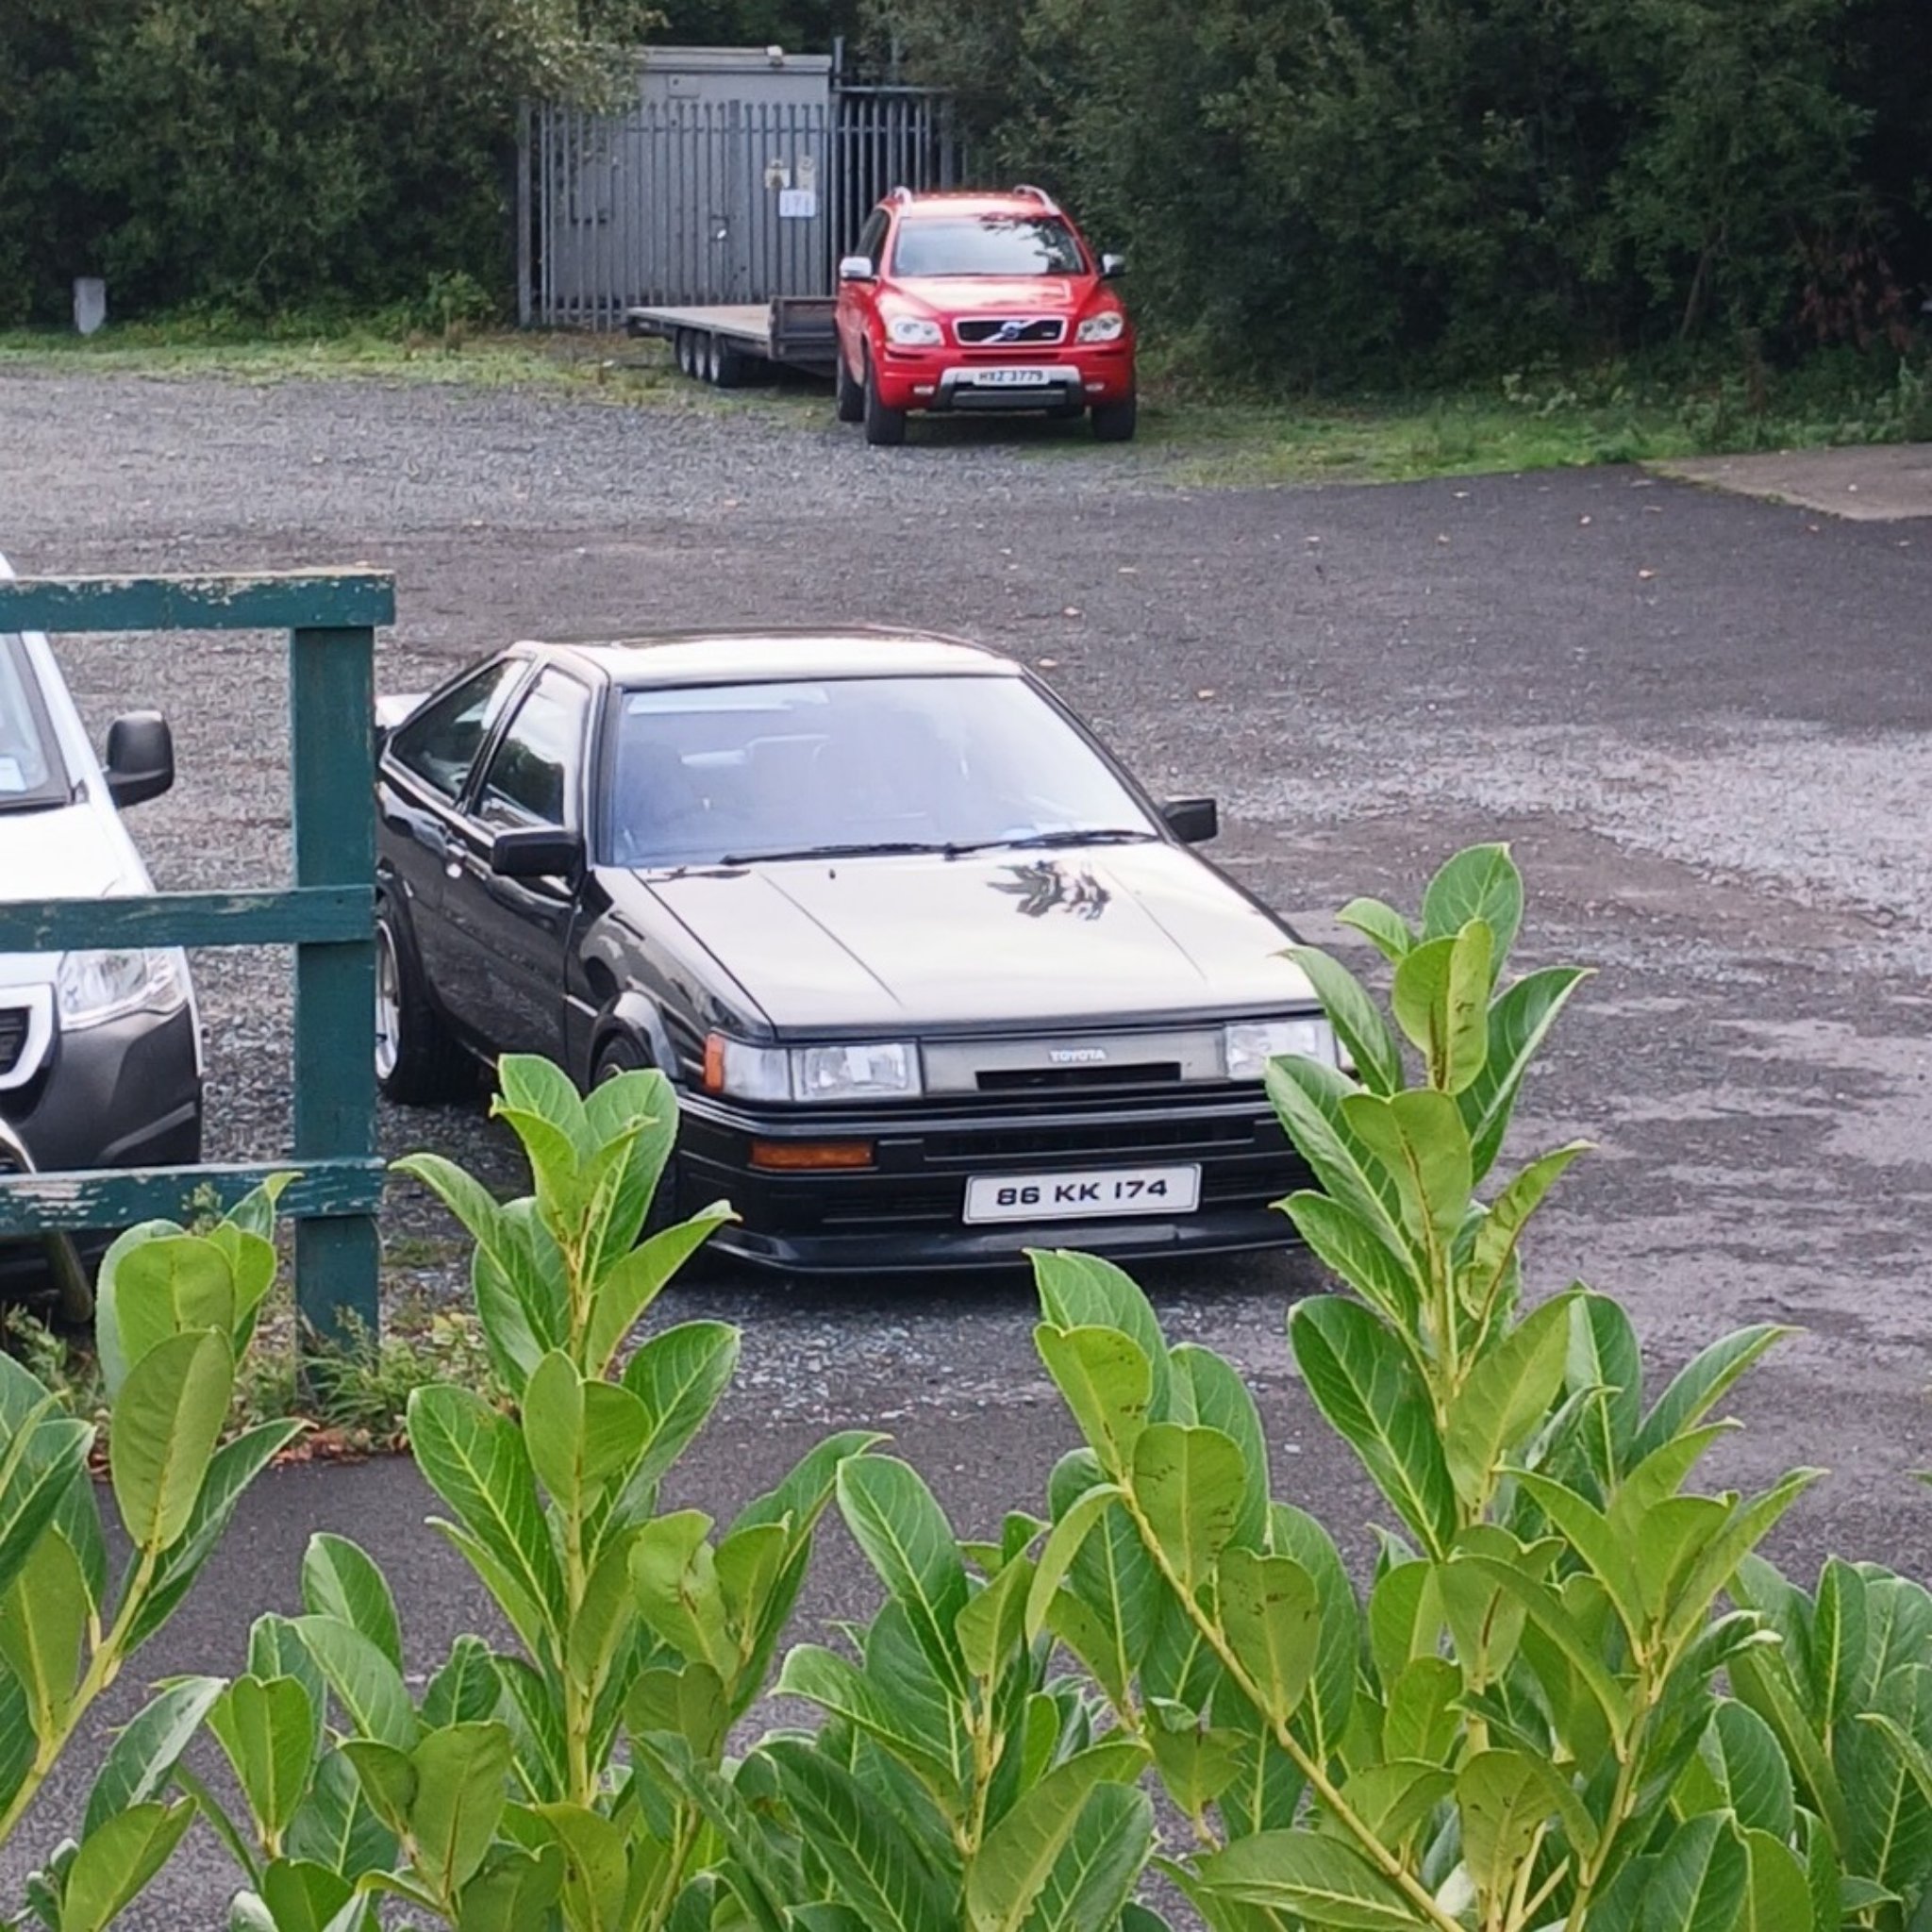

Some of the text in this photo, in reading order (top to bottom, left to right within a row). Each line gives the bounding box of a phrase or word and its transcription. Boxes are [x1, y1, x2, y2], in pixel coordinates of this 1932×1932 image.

[1049, 1048, 1107, 1062] TOYOTA
[996, 1179, 1168, 1206] 86 KK 174
